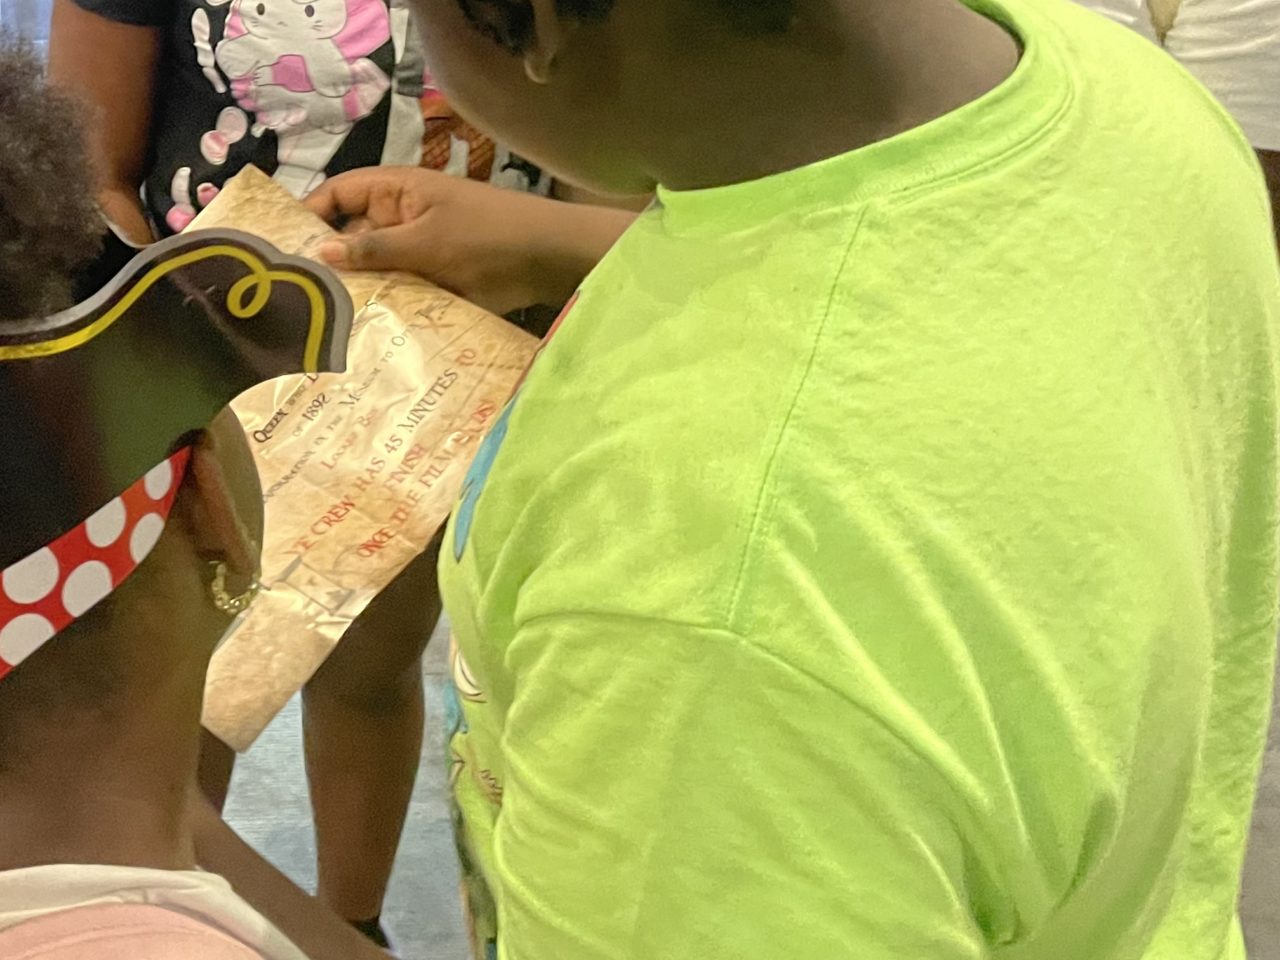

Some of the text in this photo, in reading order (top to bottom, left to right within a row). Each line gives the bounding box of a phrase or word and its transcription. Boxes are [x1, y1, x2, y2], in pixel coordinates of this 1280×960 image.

[302, 391, 331, 421] 1892
[311, 495, 357, 539] CREW
[357, 457, 385, 489] HAS
[385, 434, 402, 454] 45
[398, 369, 460, 433] MINUTES
[456, 348, 477, 369] TO
[358, 522, 396, 559] ONCE
[390, 489, 420, 526] THE
[422, 447, 456, 488] FILM
[387, 445, 427, 488] FINISH
